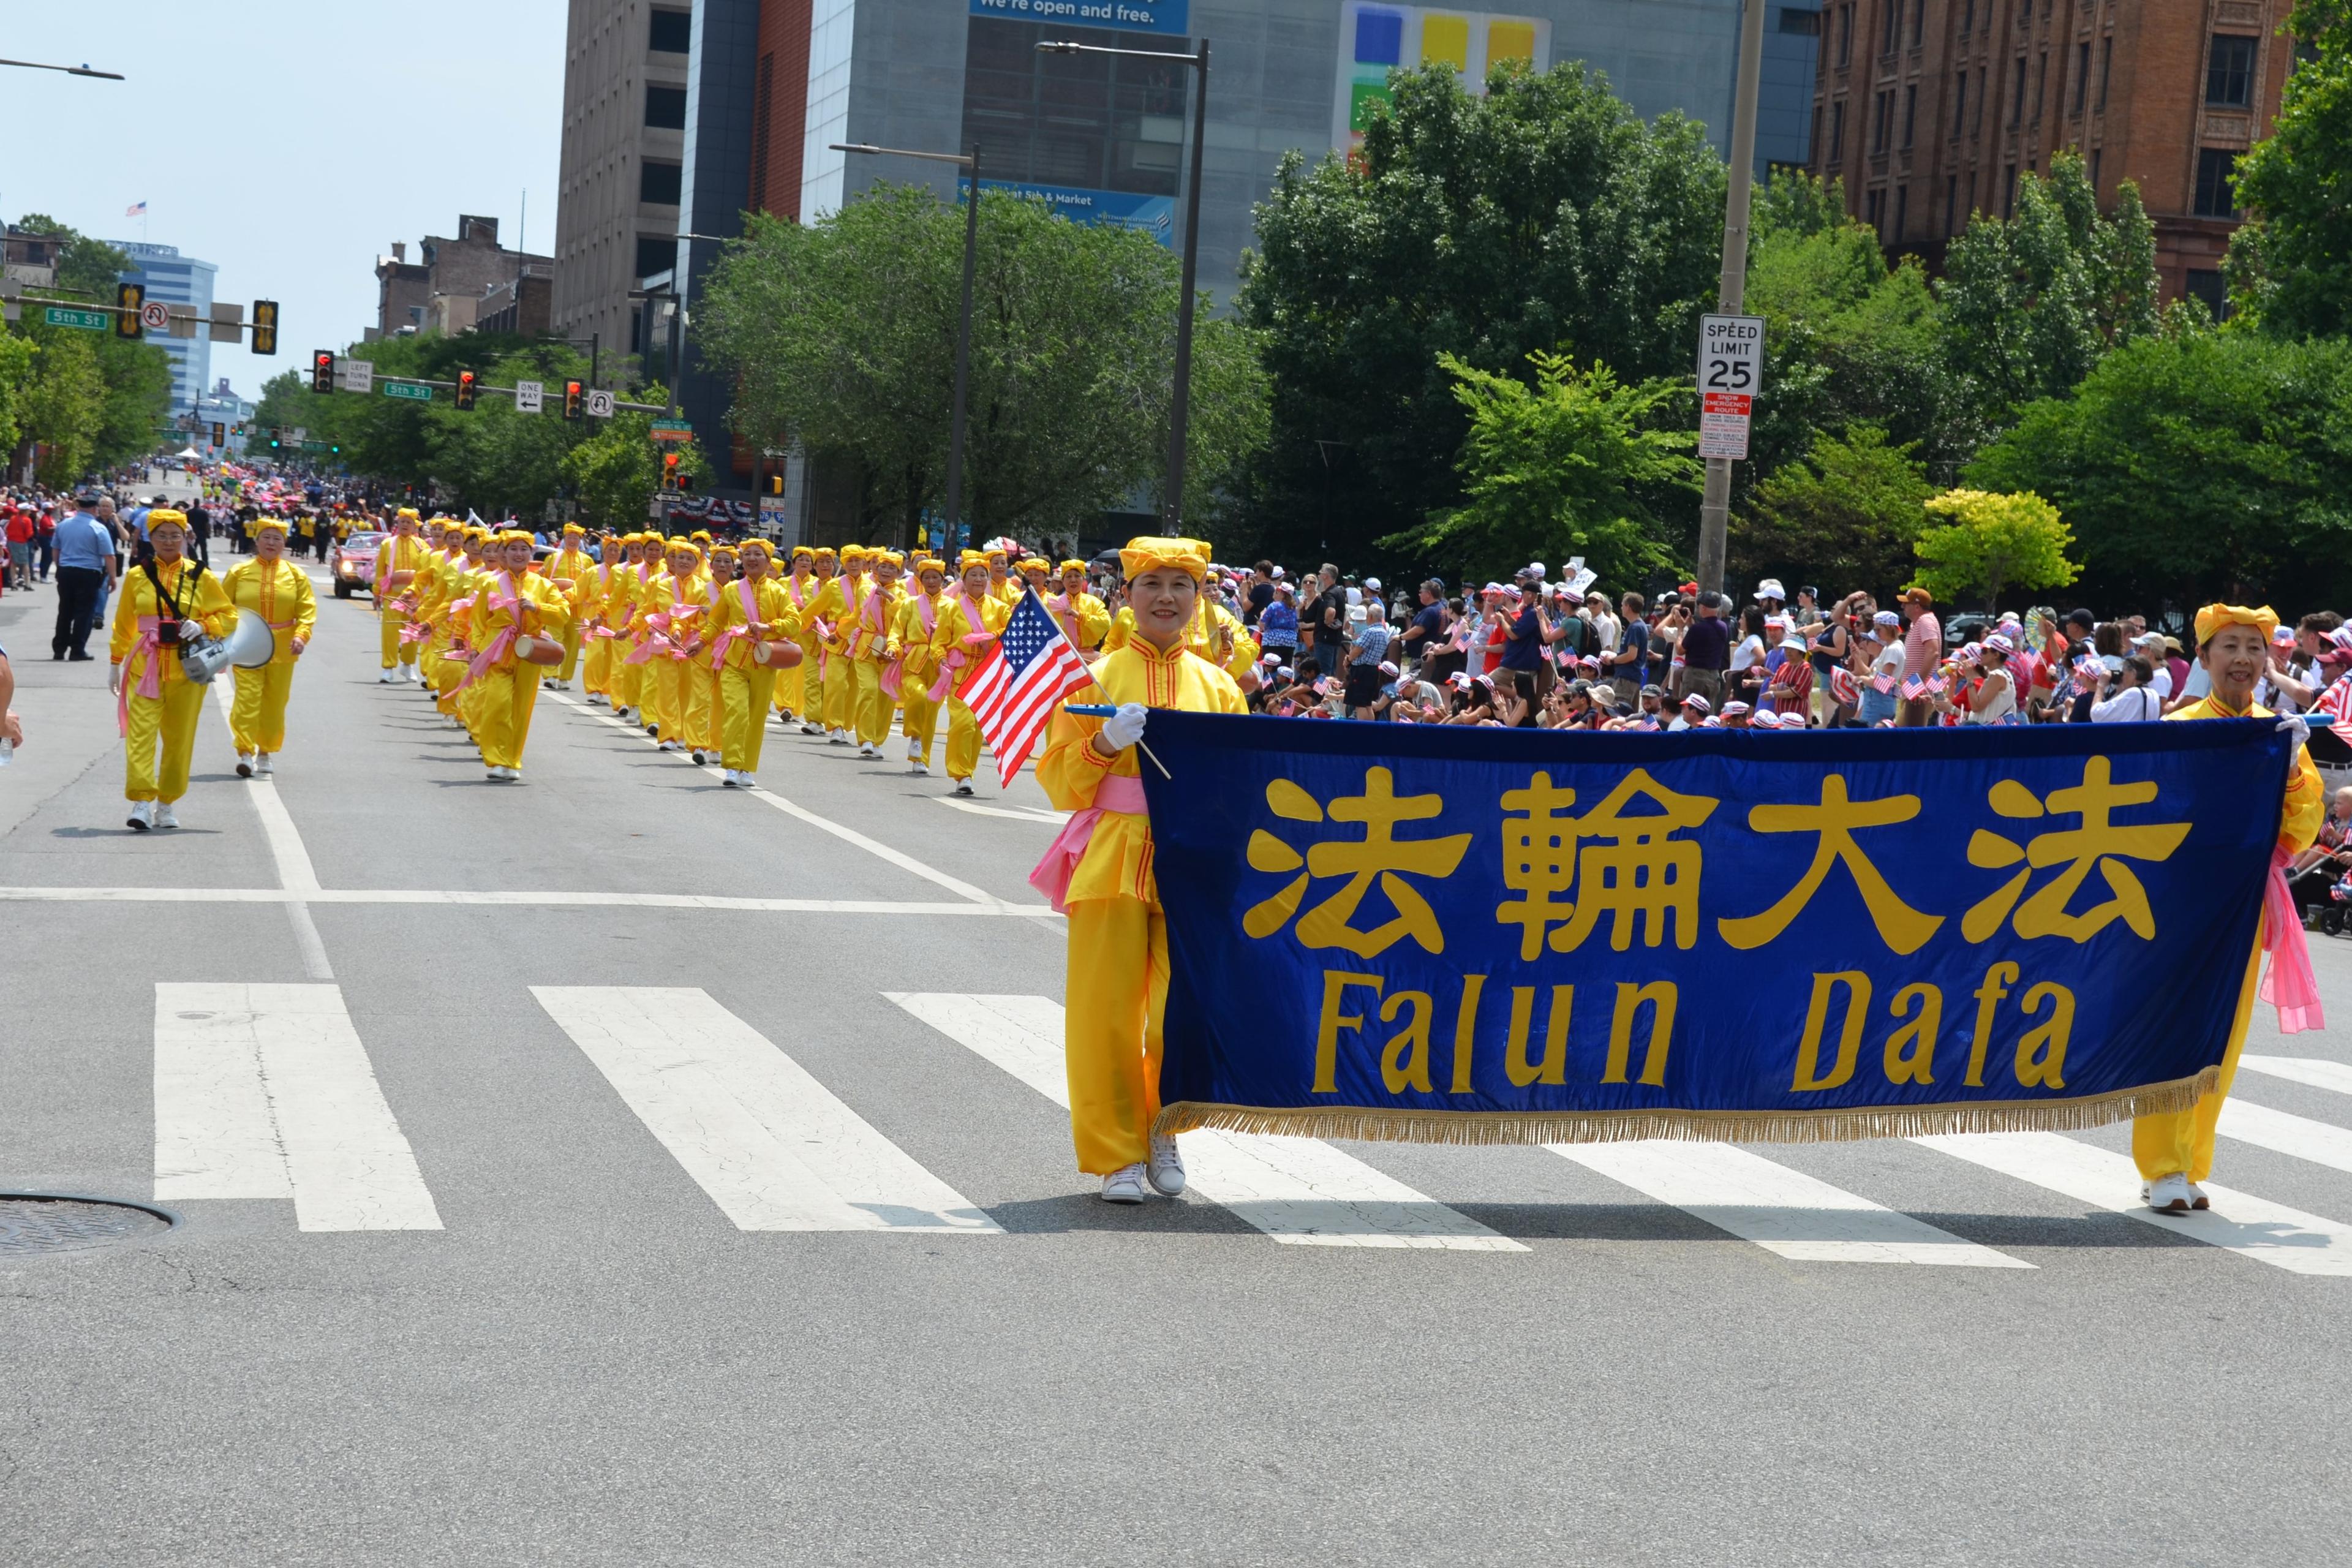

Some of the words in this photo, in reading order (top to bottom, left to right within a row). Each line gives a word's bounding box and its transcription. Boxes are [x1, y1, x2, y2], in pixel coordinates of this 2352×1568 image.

[980, 0, 1028, 10] ere
[1033, 1, 1076, 15] open
[1080, 3, 1112, 19] and
[1117, 4, 1155, 23] free.
[1025, 190, 1043, 200] 5th
[1046, 192, 1053, 202] &
[1056, 194, 1092, 206] Market
[53, 311, 78, 323] 5th
[85, 314, 100, 326] St
[1707, 324, 1758, 339] SPEED
[1711, 341, 1752, 355] LIMIT
[1708, 360, 1752, 389] 25
[390, 385, 409, 395] 5th
[413, 388, 426, 397] St
[521, 383, 539, 392] ONE
[1244, 755, 2192, 960] 法輪大法
[1313, 970, 1678, 1093] Falun
[1791, 962, 2075, 1091] Dafa
